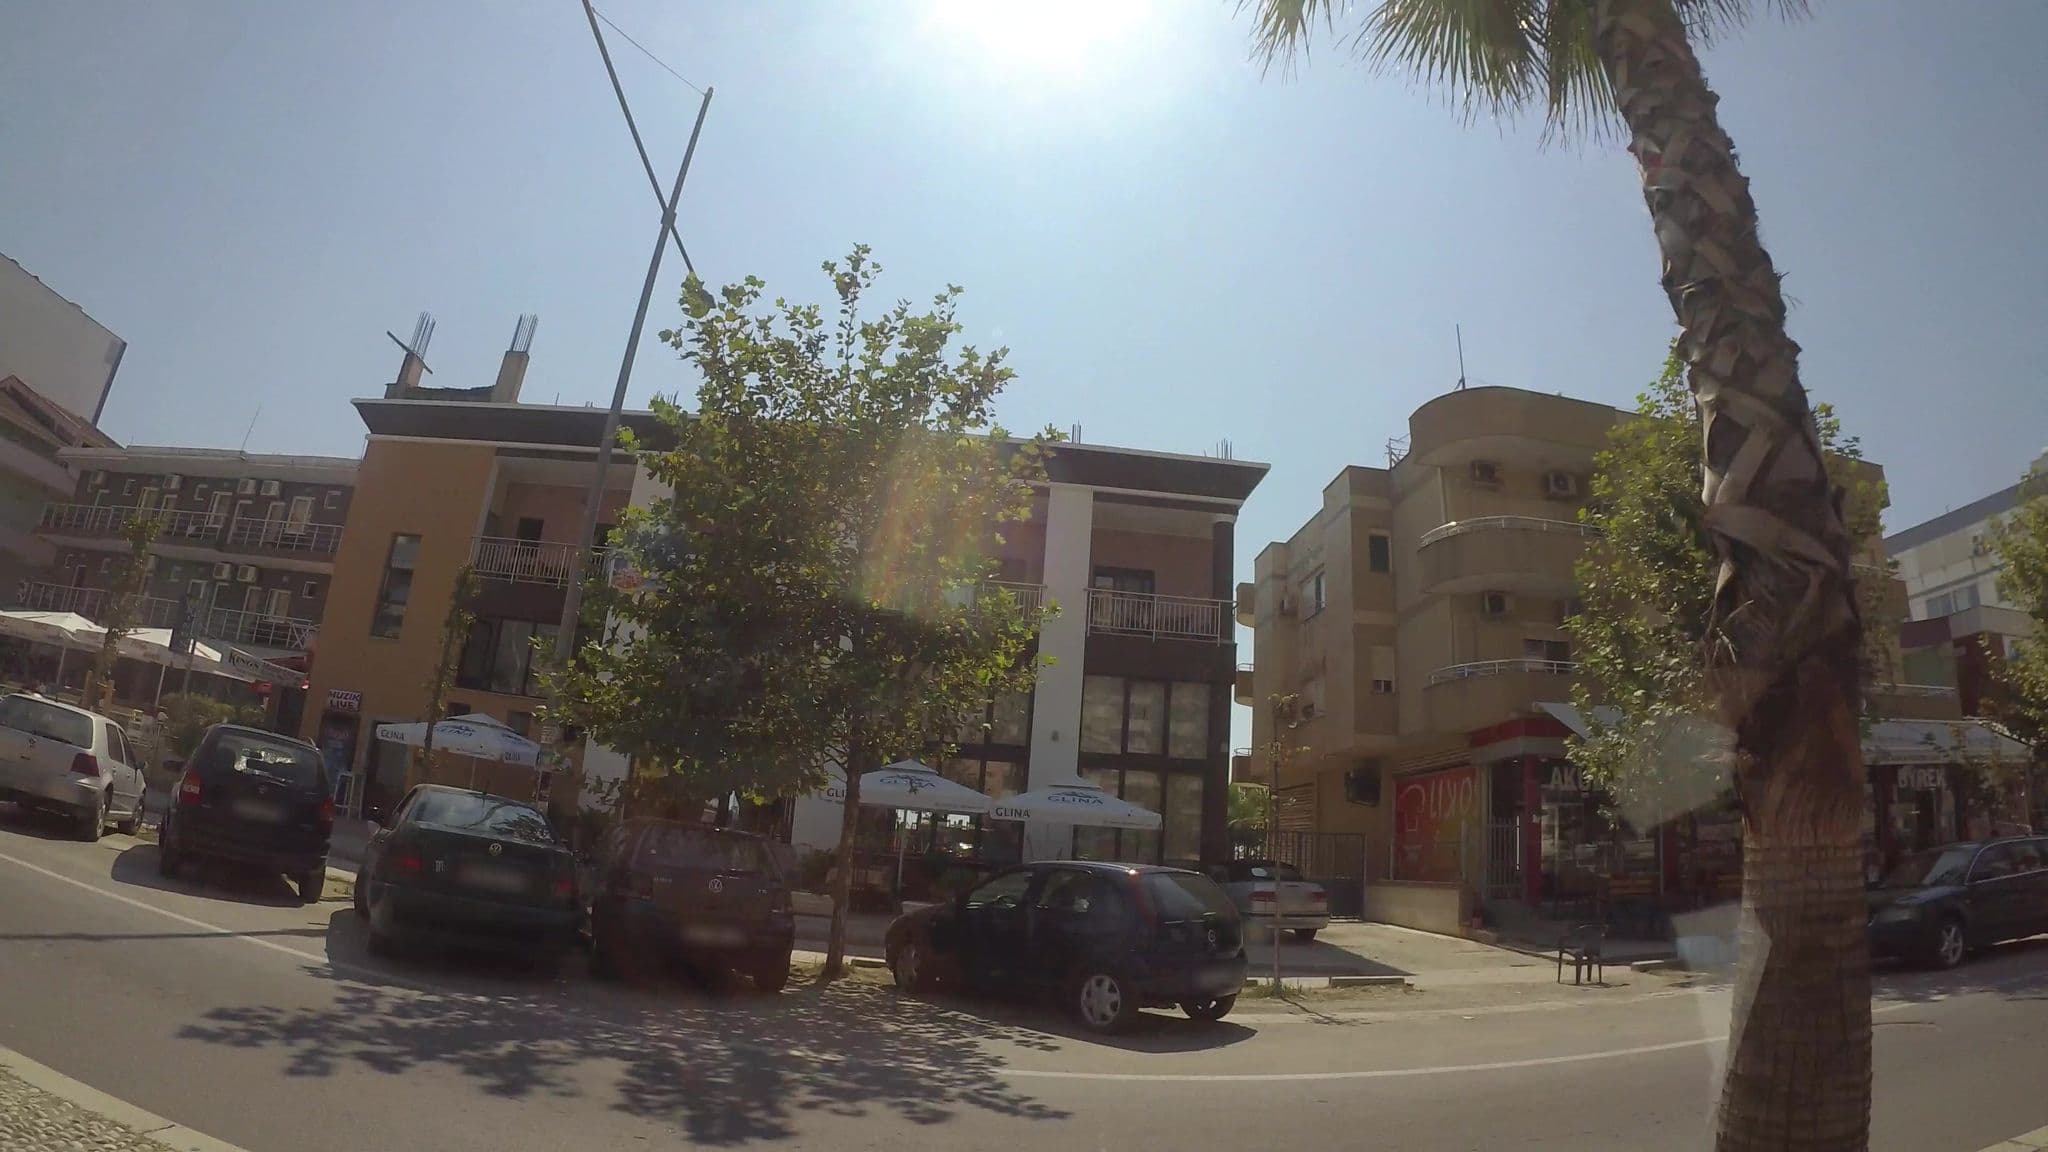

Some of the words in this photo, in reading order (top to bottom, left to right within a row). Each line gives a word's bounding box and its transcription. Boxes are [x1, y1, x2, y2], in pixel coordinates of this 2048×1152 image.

[328, 689, 360, 701] MUZIK
[827, 787, 845, 798] GLI
[1047, 795, 1104, 805] GLINA
[995, 807, 1030, 817] GLINA
